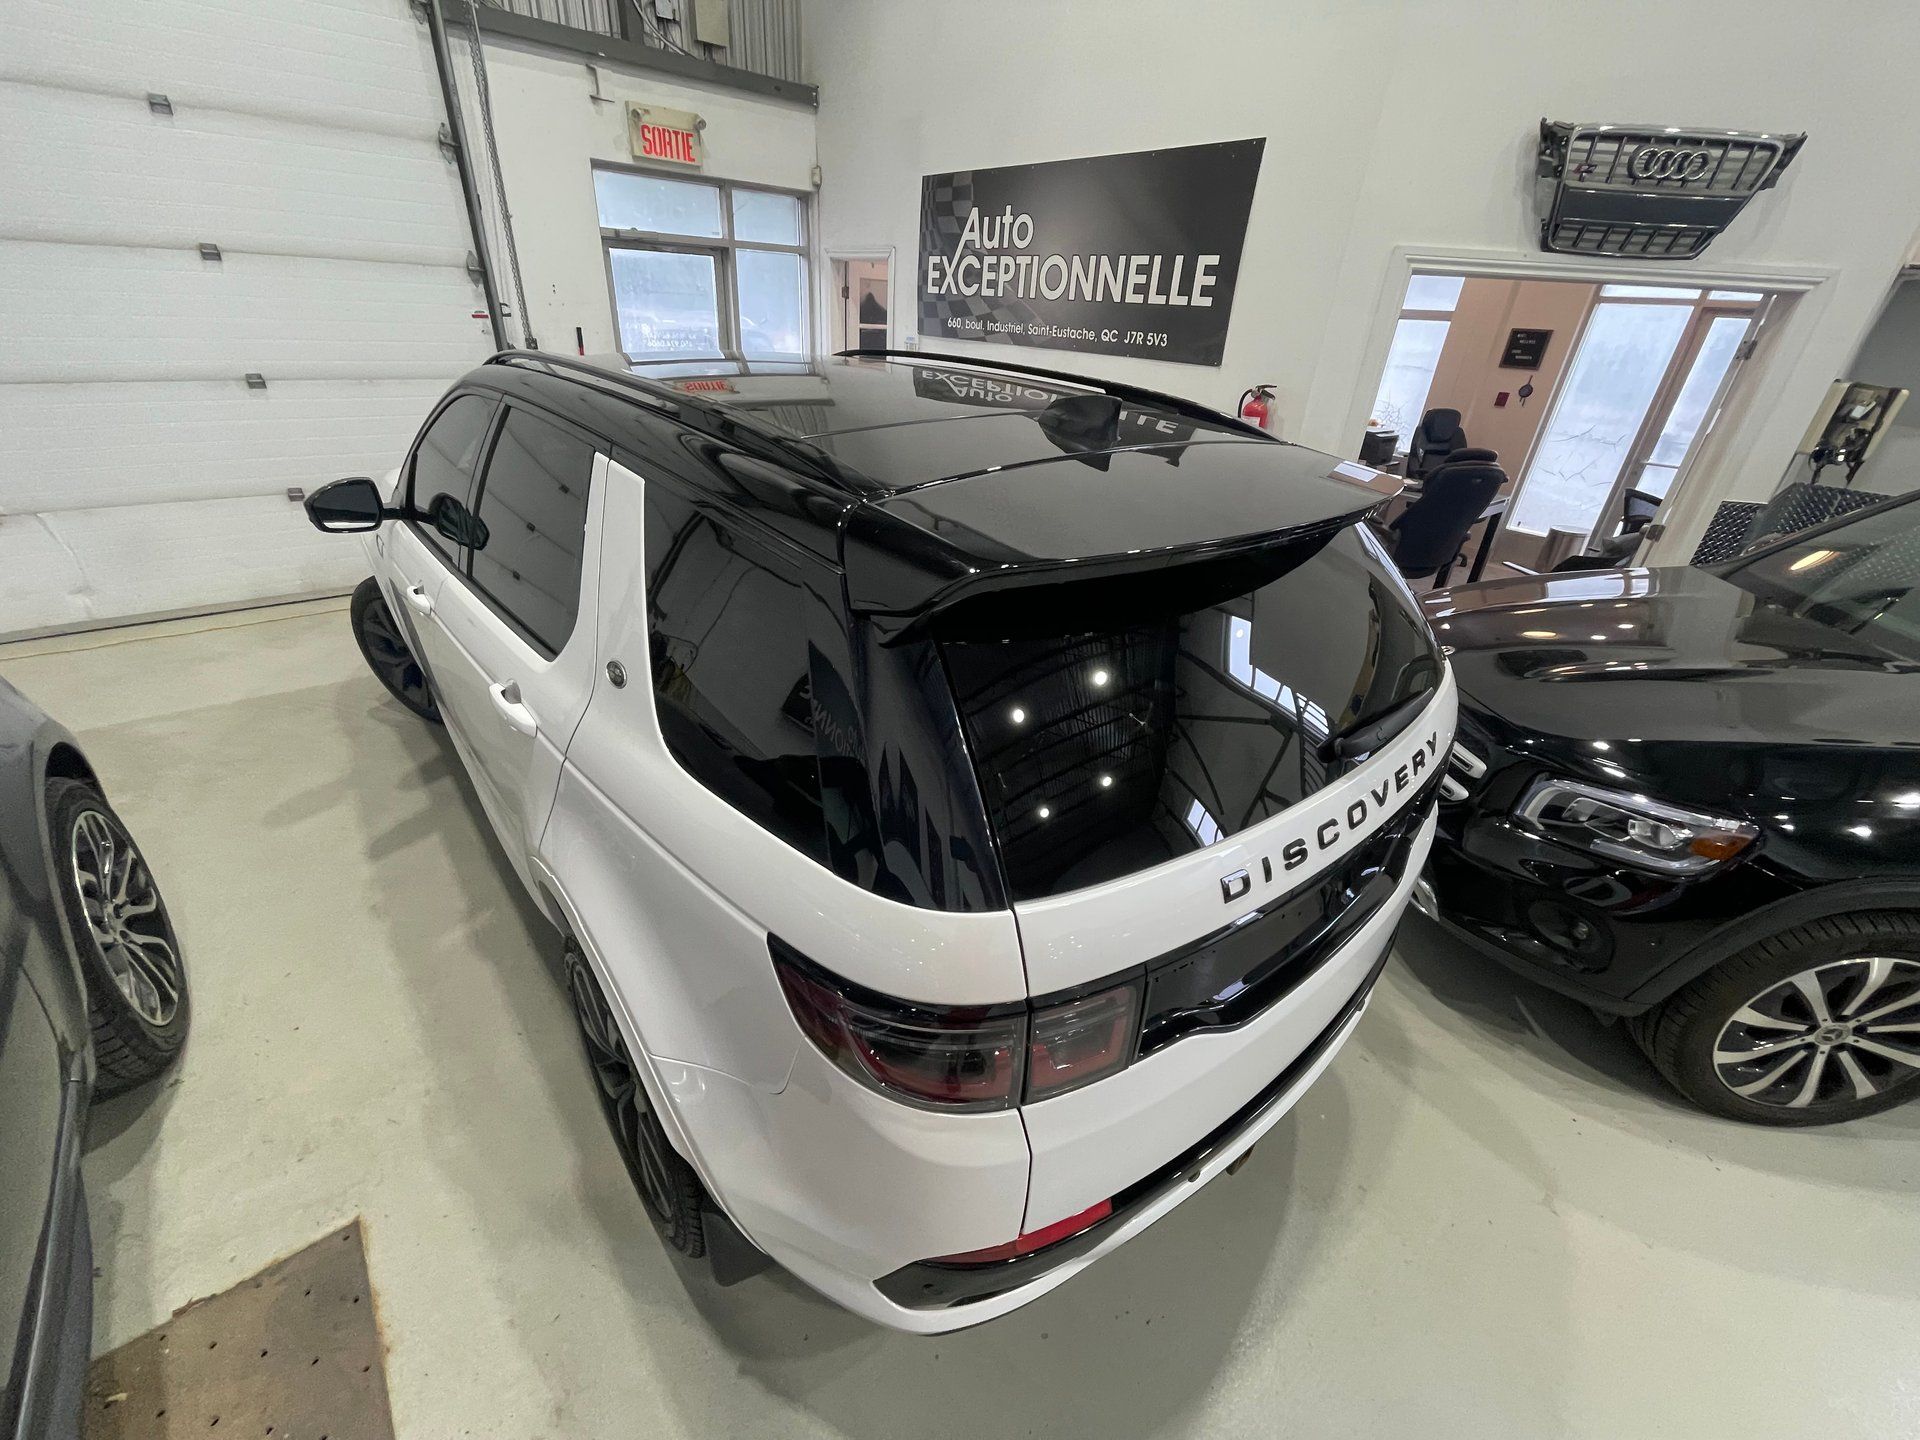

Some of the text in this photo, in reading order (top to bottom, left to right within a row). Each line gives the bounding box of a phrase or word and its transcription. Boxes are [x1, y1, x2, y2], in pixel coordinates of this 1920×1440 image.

[641, 124, 696, 162] SORTIE
[954, 204, 1035, 256] Auto
[926, 253, 1221, 307] EXCEPTIONNELLE
[947, 317, 1169, 347] 660, boul. Industriel, Saint-Eustache, QC J7R 5V3
[1220, 731, 1437, 904] DISCOVERY
